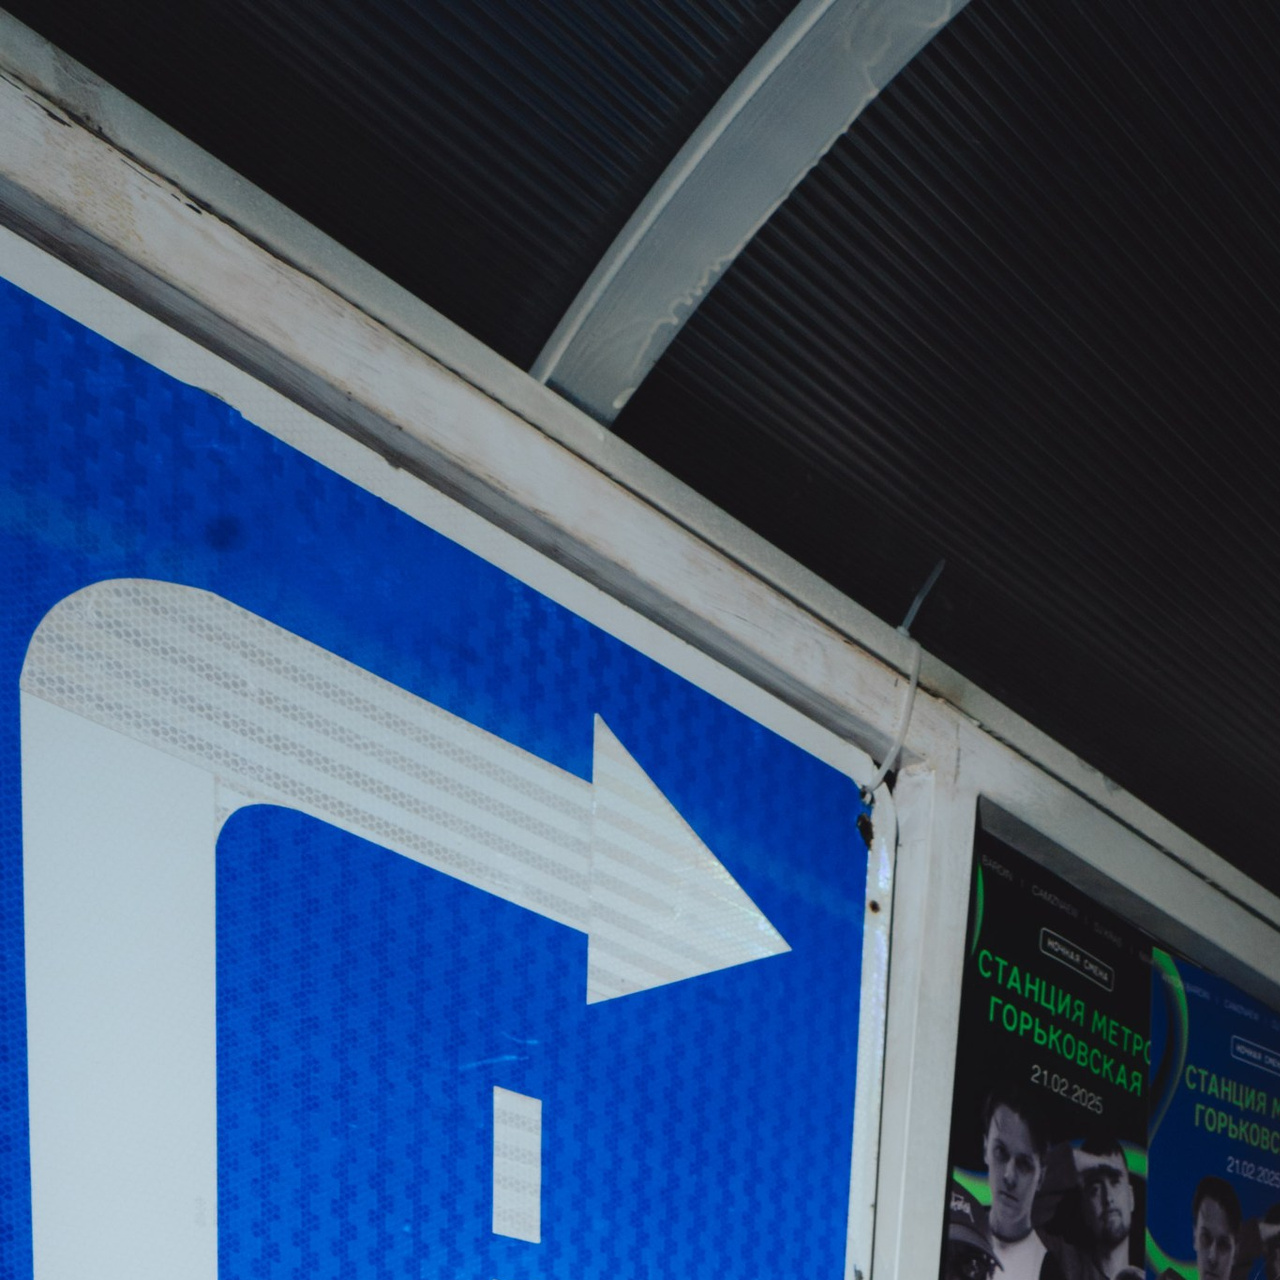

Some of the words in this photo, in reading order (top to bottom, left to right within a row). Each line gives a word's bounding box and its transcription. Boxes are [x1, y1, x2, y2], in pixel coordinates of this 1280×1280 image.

[977, 949, 1086, 1027] СТАНЦИЯ
[988, 995, 1144, 1098] ГОРЬКОВСКАЯ
[1030, 1064, 1104, 1116] 21.02.2025
[1184, 1063, 1268, 1115] СТАНЦИЯ
